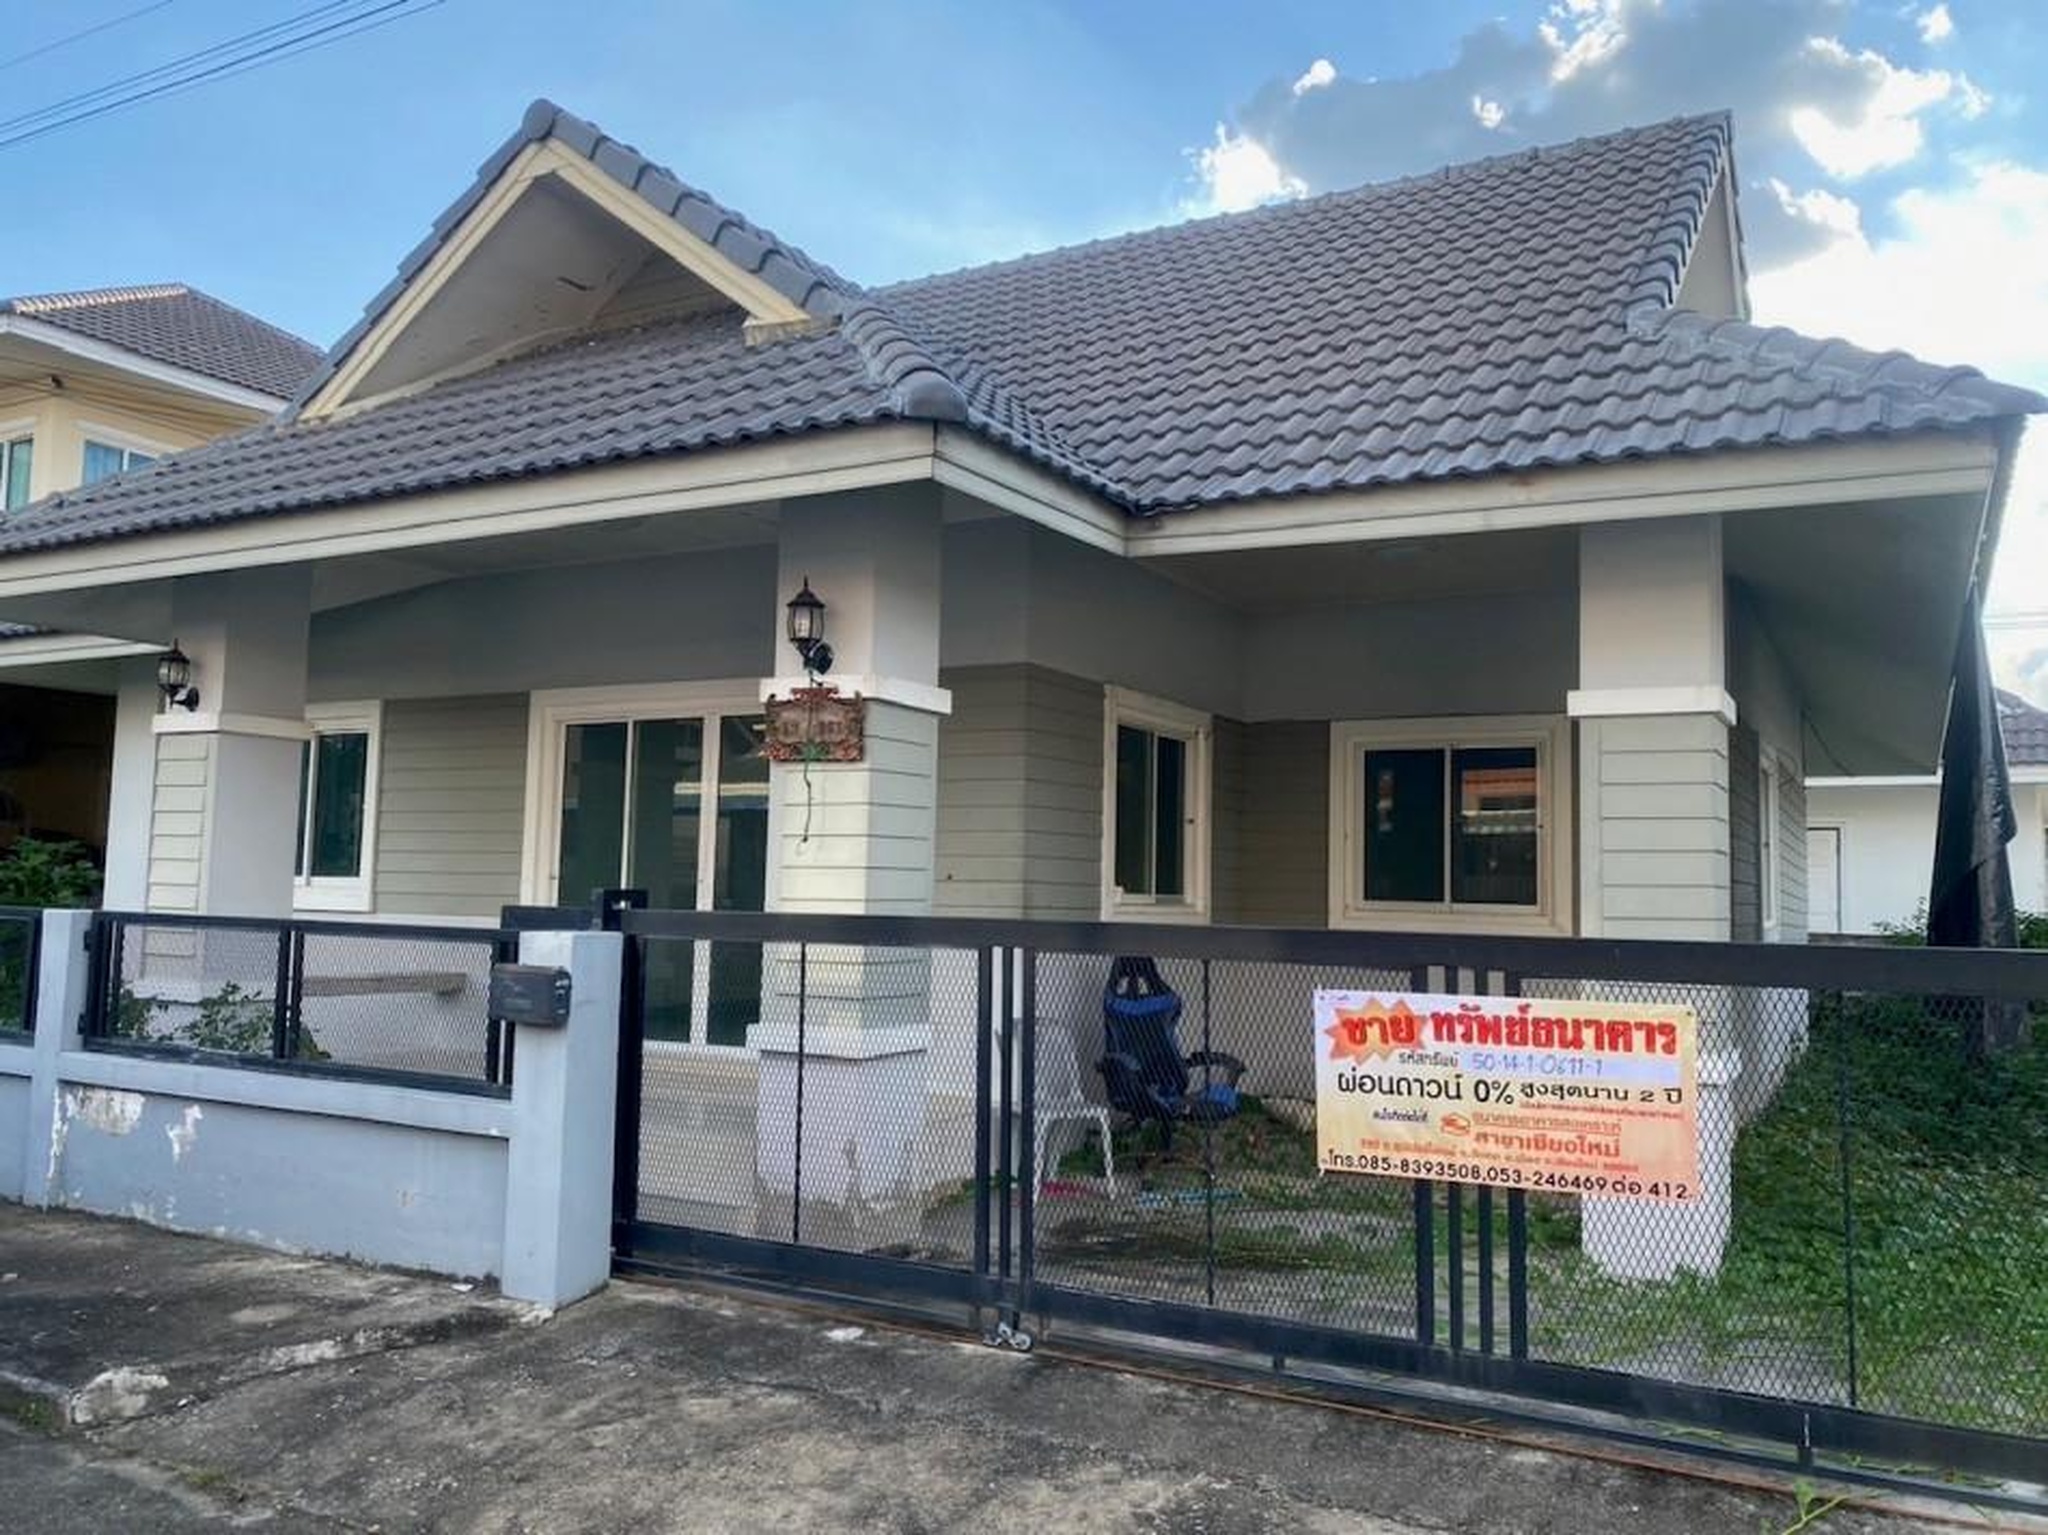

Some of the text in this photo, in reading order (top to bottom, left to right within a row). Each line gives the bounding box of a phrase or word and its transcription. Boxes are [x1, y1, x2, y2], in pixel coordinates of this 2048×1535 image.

[1342, 1003, 1677, 1055] ขาย ทรัพย์ธนาคาร
[1338, 1066, 1683, 1105] ผ่อนดาวน์ 0% สูงสุดนาน 2 ปี
[1611, 1174, 1642, 1195] ต่อ
[1649, 1182, 1688, 1200] 412
